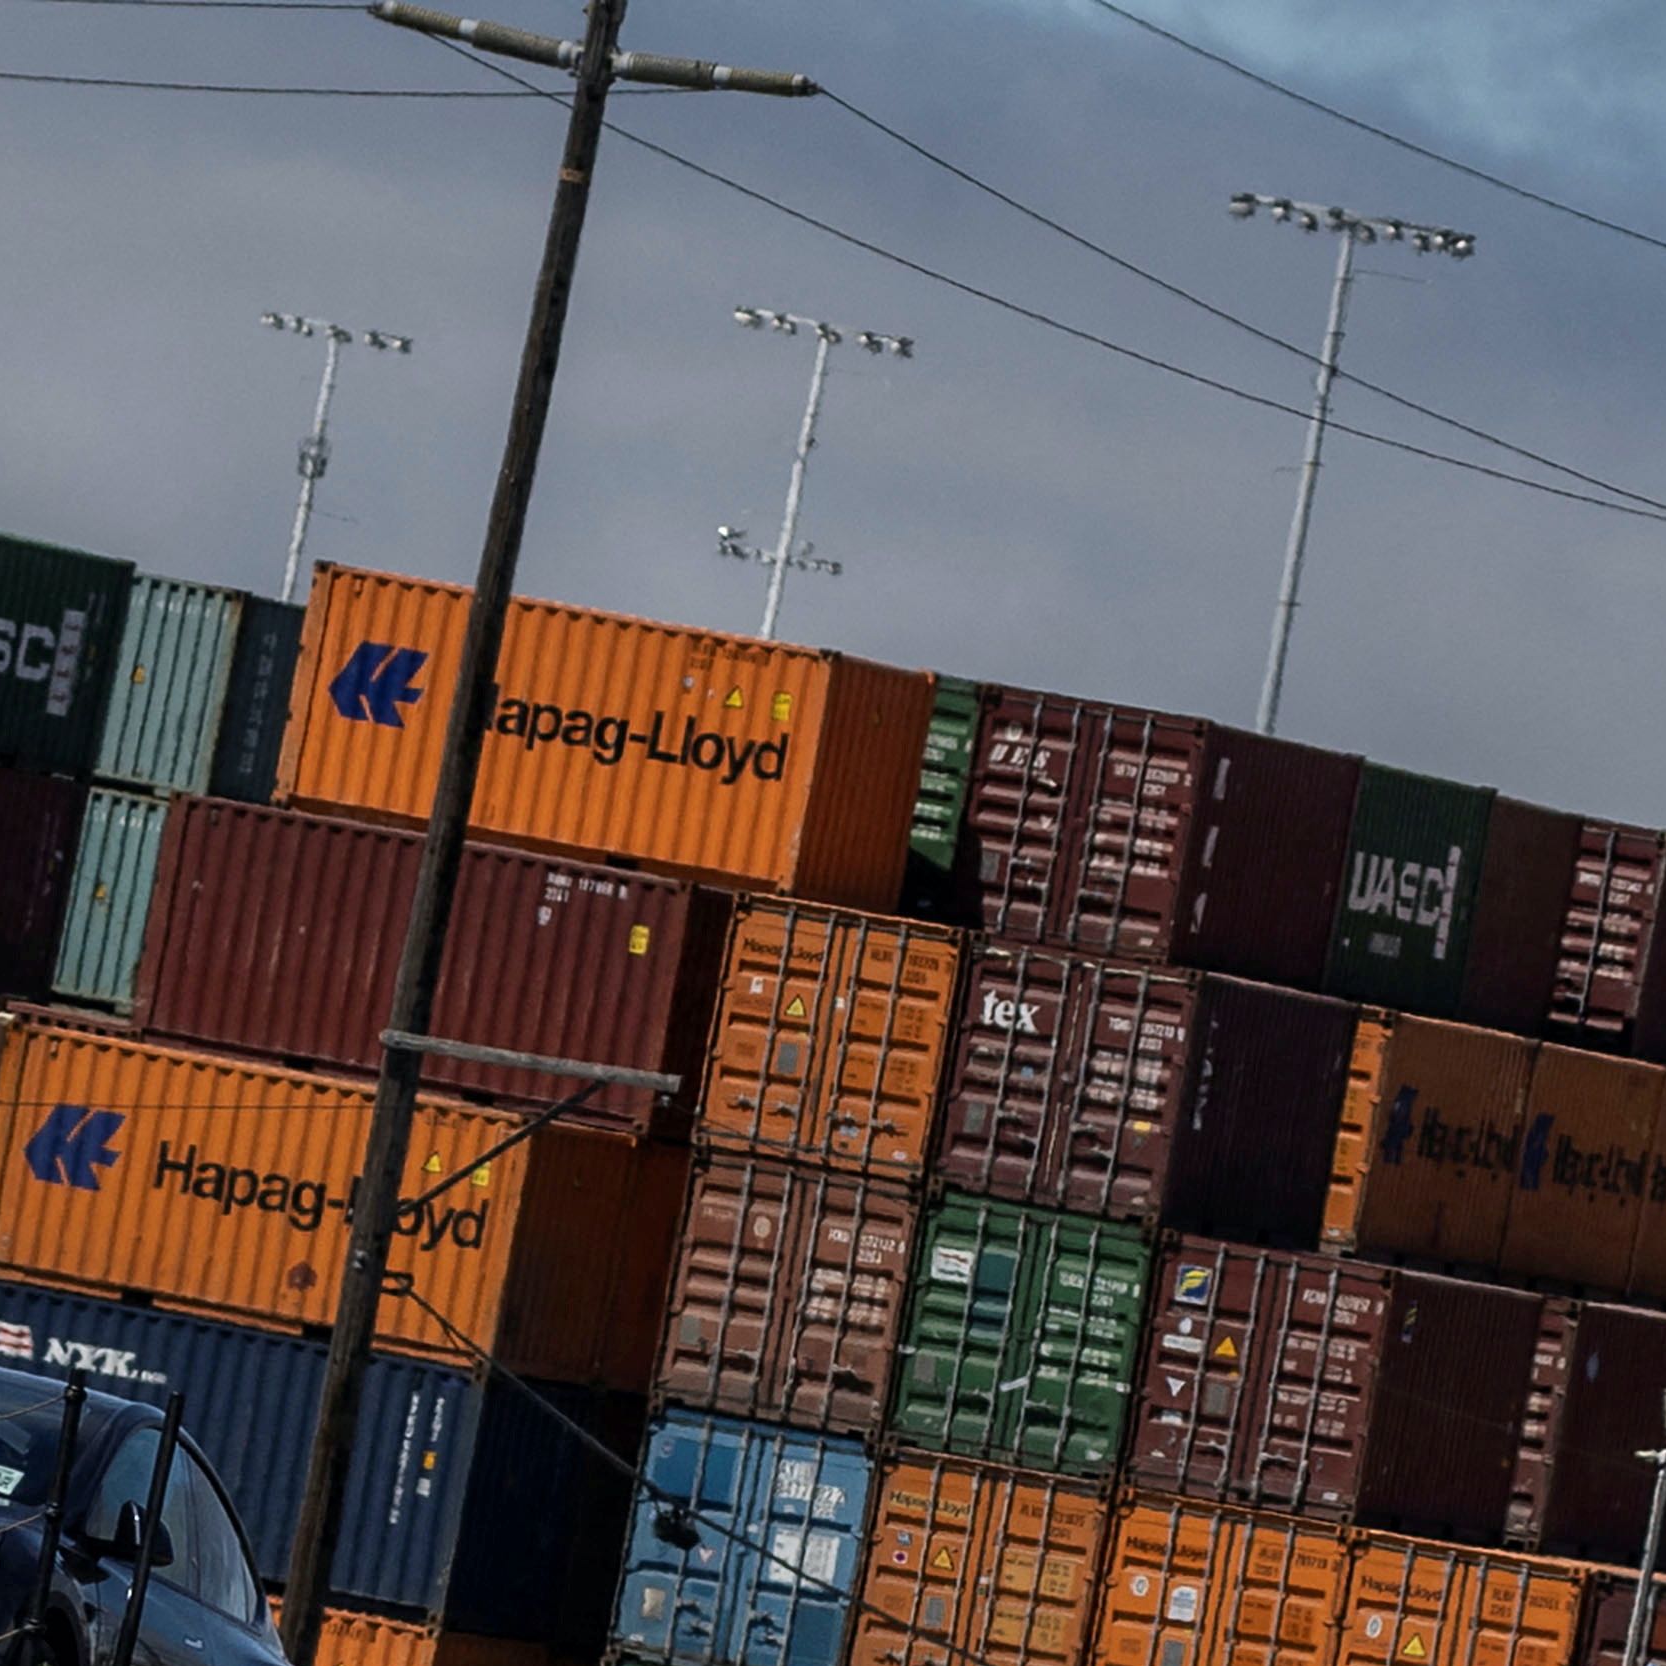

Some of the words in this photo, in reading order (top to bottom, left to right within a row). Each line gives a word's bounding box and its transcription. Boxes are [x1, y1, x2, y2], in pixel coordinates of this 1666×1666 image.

[1348, 851, 1446, 927] UASC
[981, 988, 1041, 1035] tex
[153, 1140, 488, 1251] Hapag-Loyd
